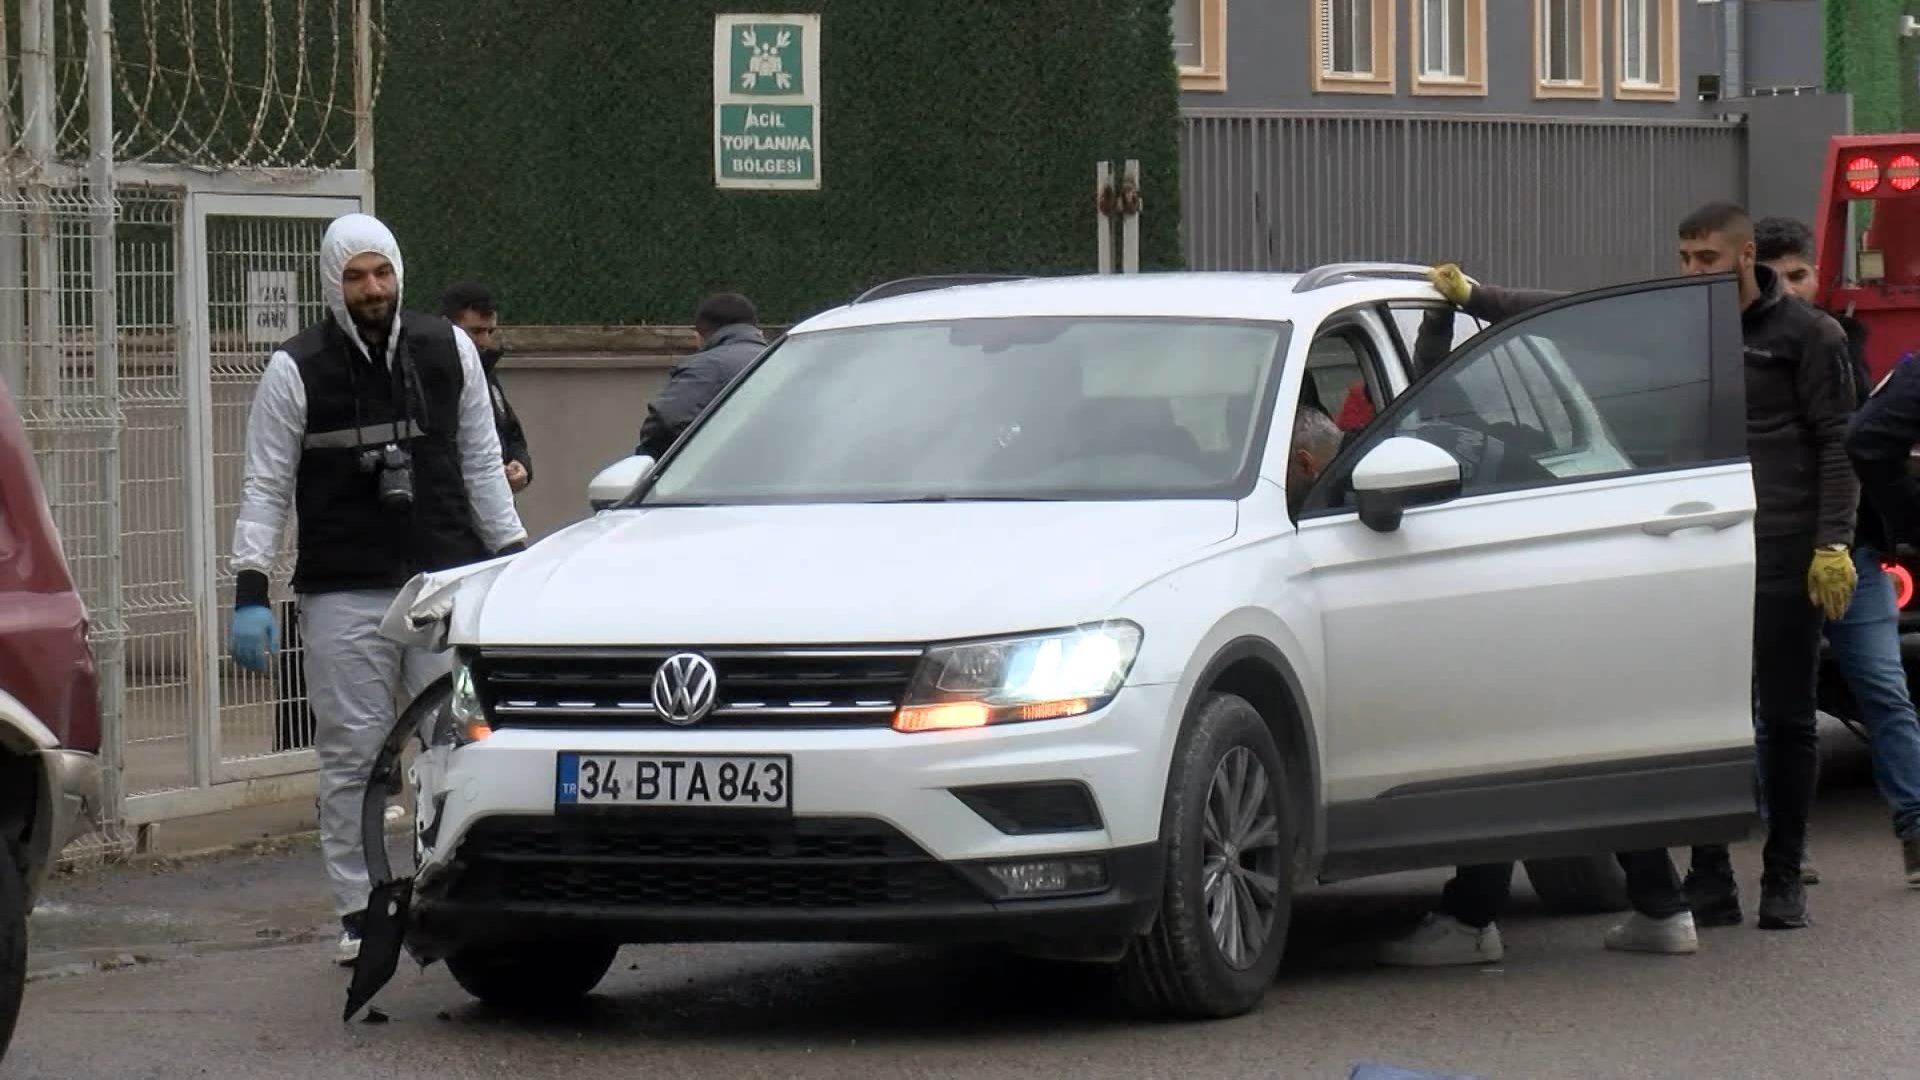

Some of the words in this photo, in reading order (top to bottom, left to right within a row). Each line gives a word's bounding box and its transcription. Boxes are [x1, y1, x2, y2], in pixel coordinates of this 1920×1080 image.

[745, 108, 784, 129] ACİL
[722, 135, 811, 150] TOPLANMA
[733, 157, 801, 173] BÖLGESİ
[563, 783, 577, 794] TR
[580, 760, 620, 800] 34
[636, 761, 710, 801] BTA
[719, 762, 783, 802] 843
